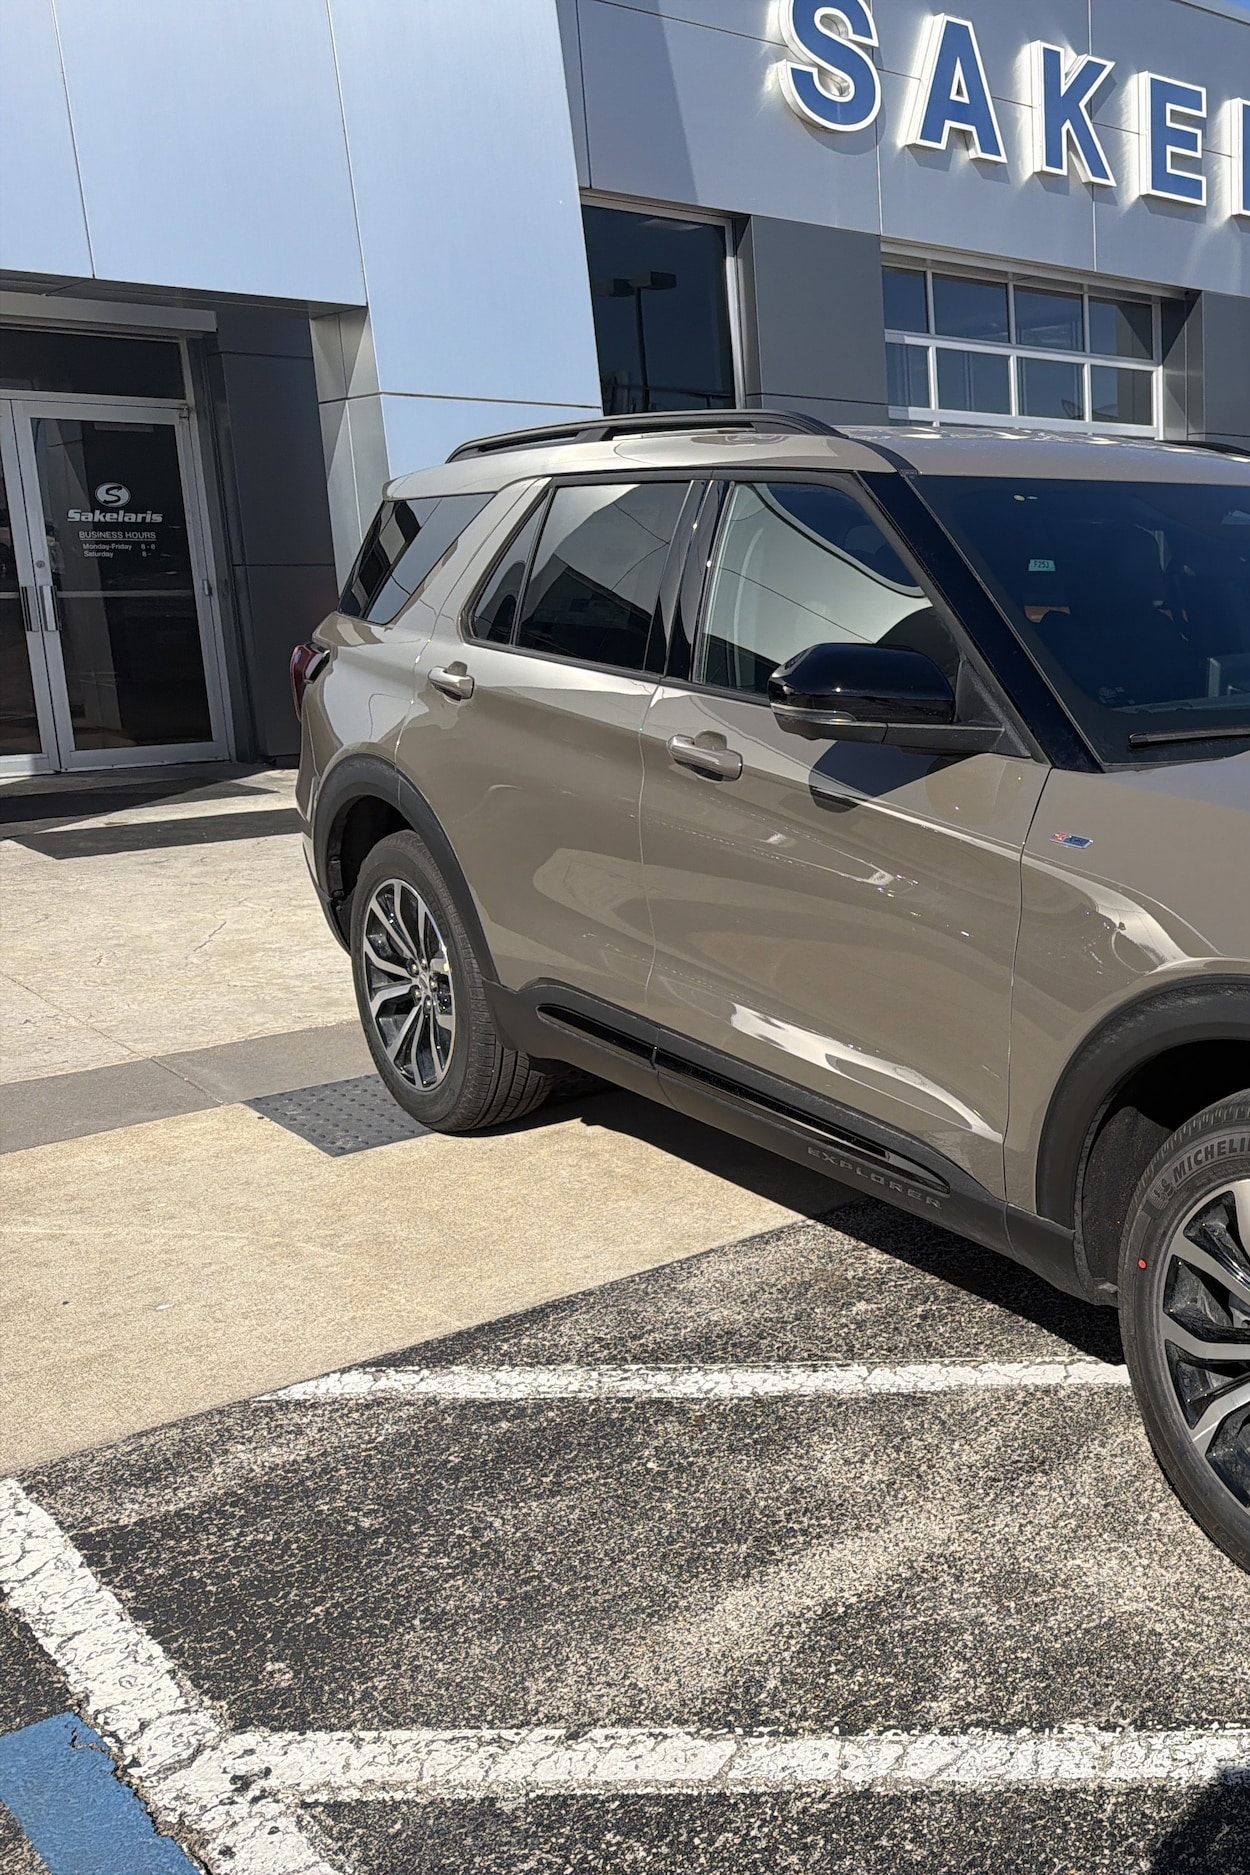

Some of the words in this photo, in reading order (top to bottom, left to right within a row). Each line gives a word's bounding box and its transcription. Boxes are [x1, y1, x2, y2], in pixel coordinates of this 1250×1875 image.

[67, 509, 163, 523] Sakelaris
[78, 531, 123, 539] BUSINESS
[125, 531, 156, 539] HOURS
[83, 543, 132, 551] Monday-Friday
[807, 1146, 942, 1209] EXPLORER
